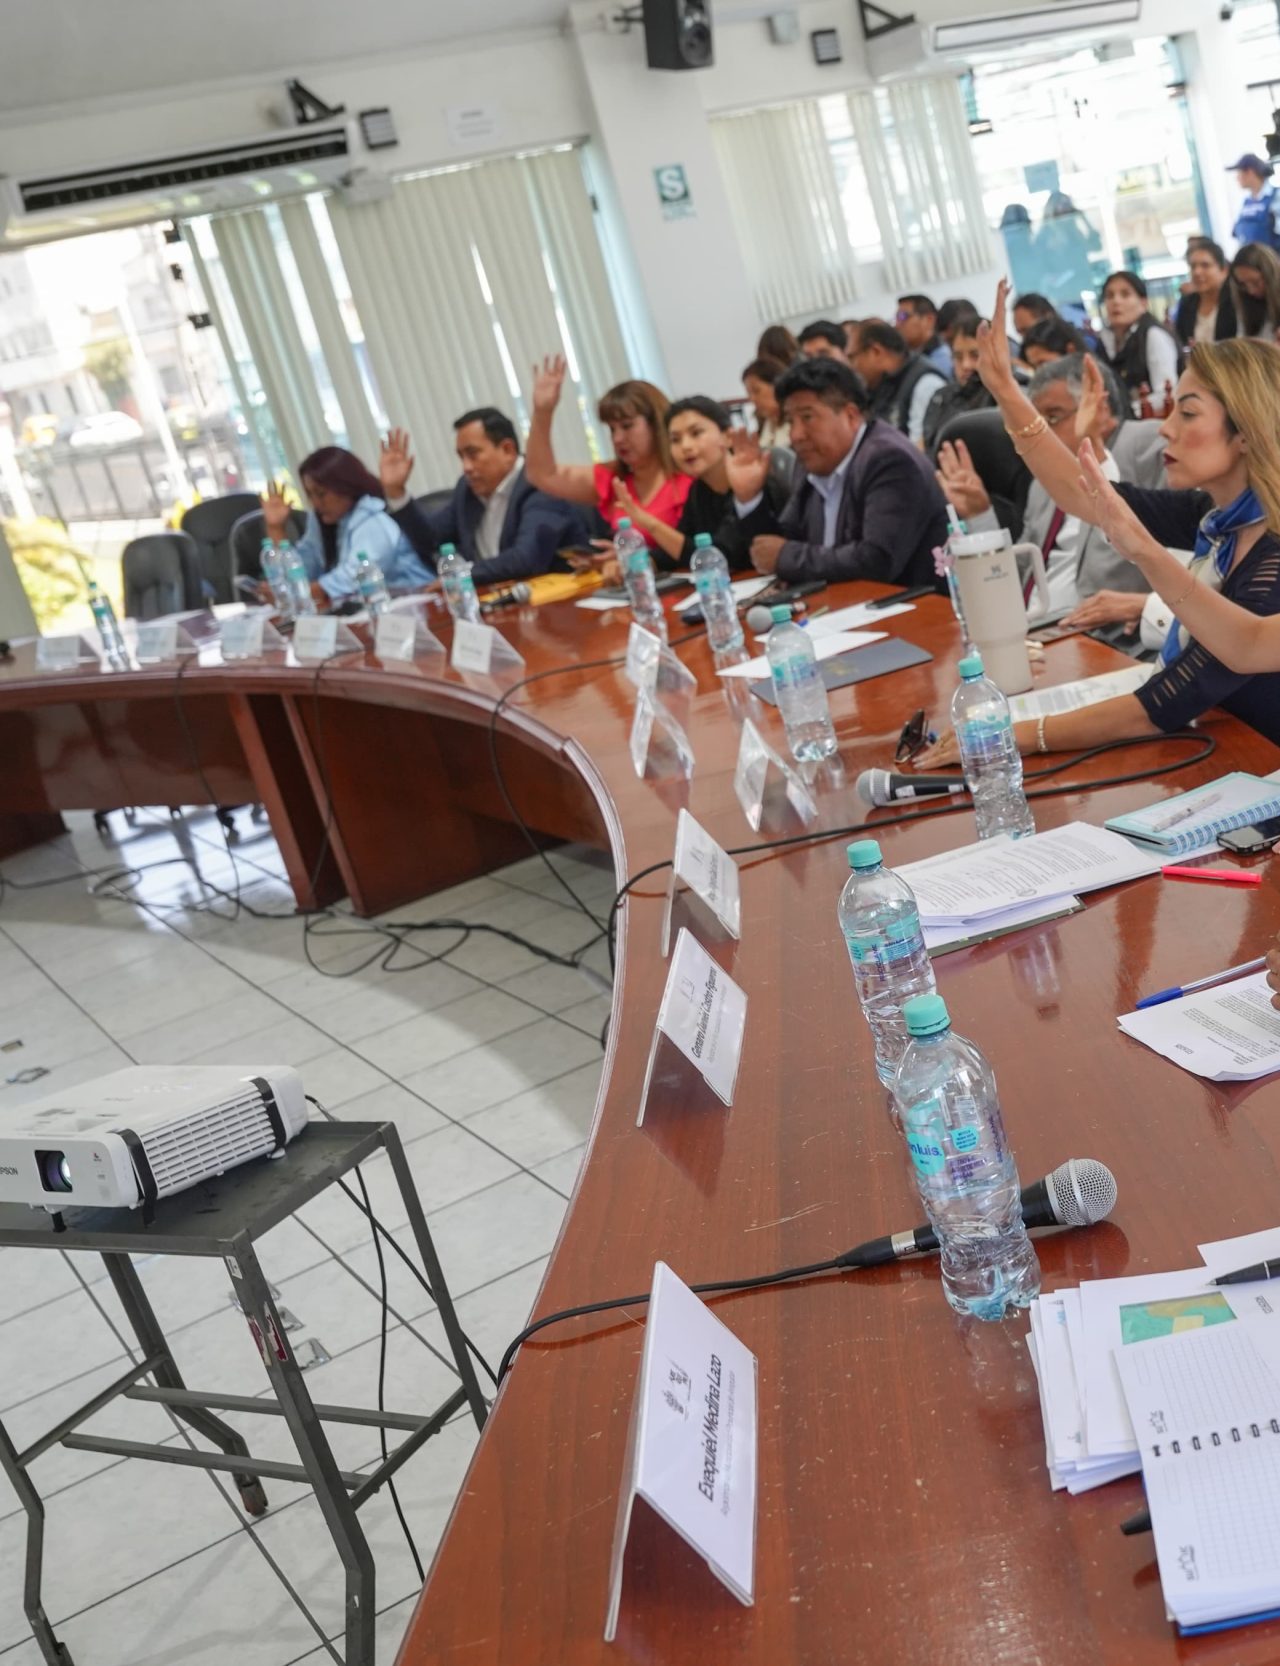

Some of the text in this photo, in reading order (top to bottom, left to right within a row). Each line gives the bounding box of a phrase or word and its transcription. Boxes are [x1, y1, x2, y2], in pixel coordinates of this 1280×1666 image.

[660, 169, 684, 200] S
[698, 1353, 721, 1501] Exequiel Medina Lazo
